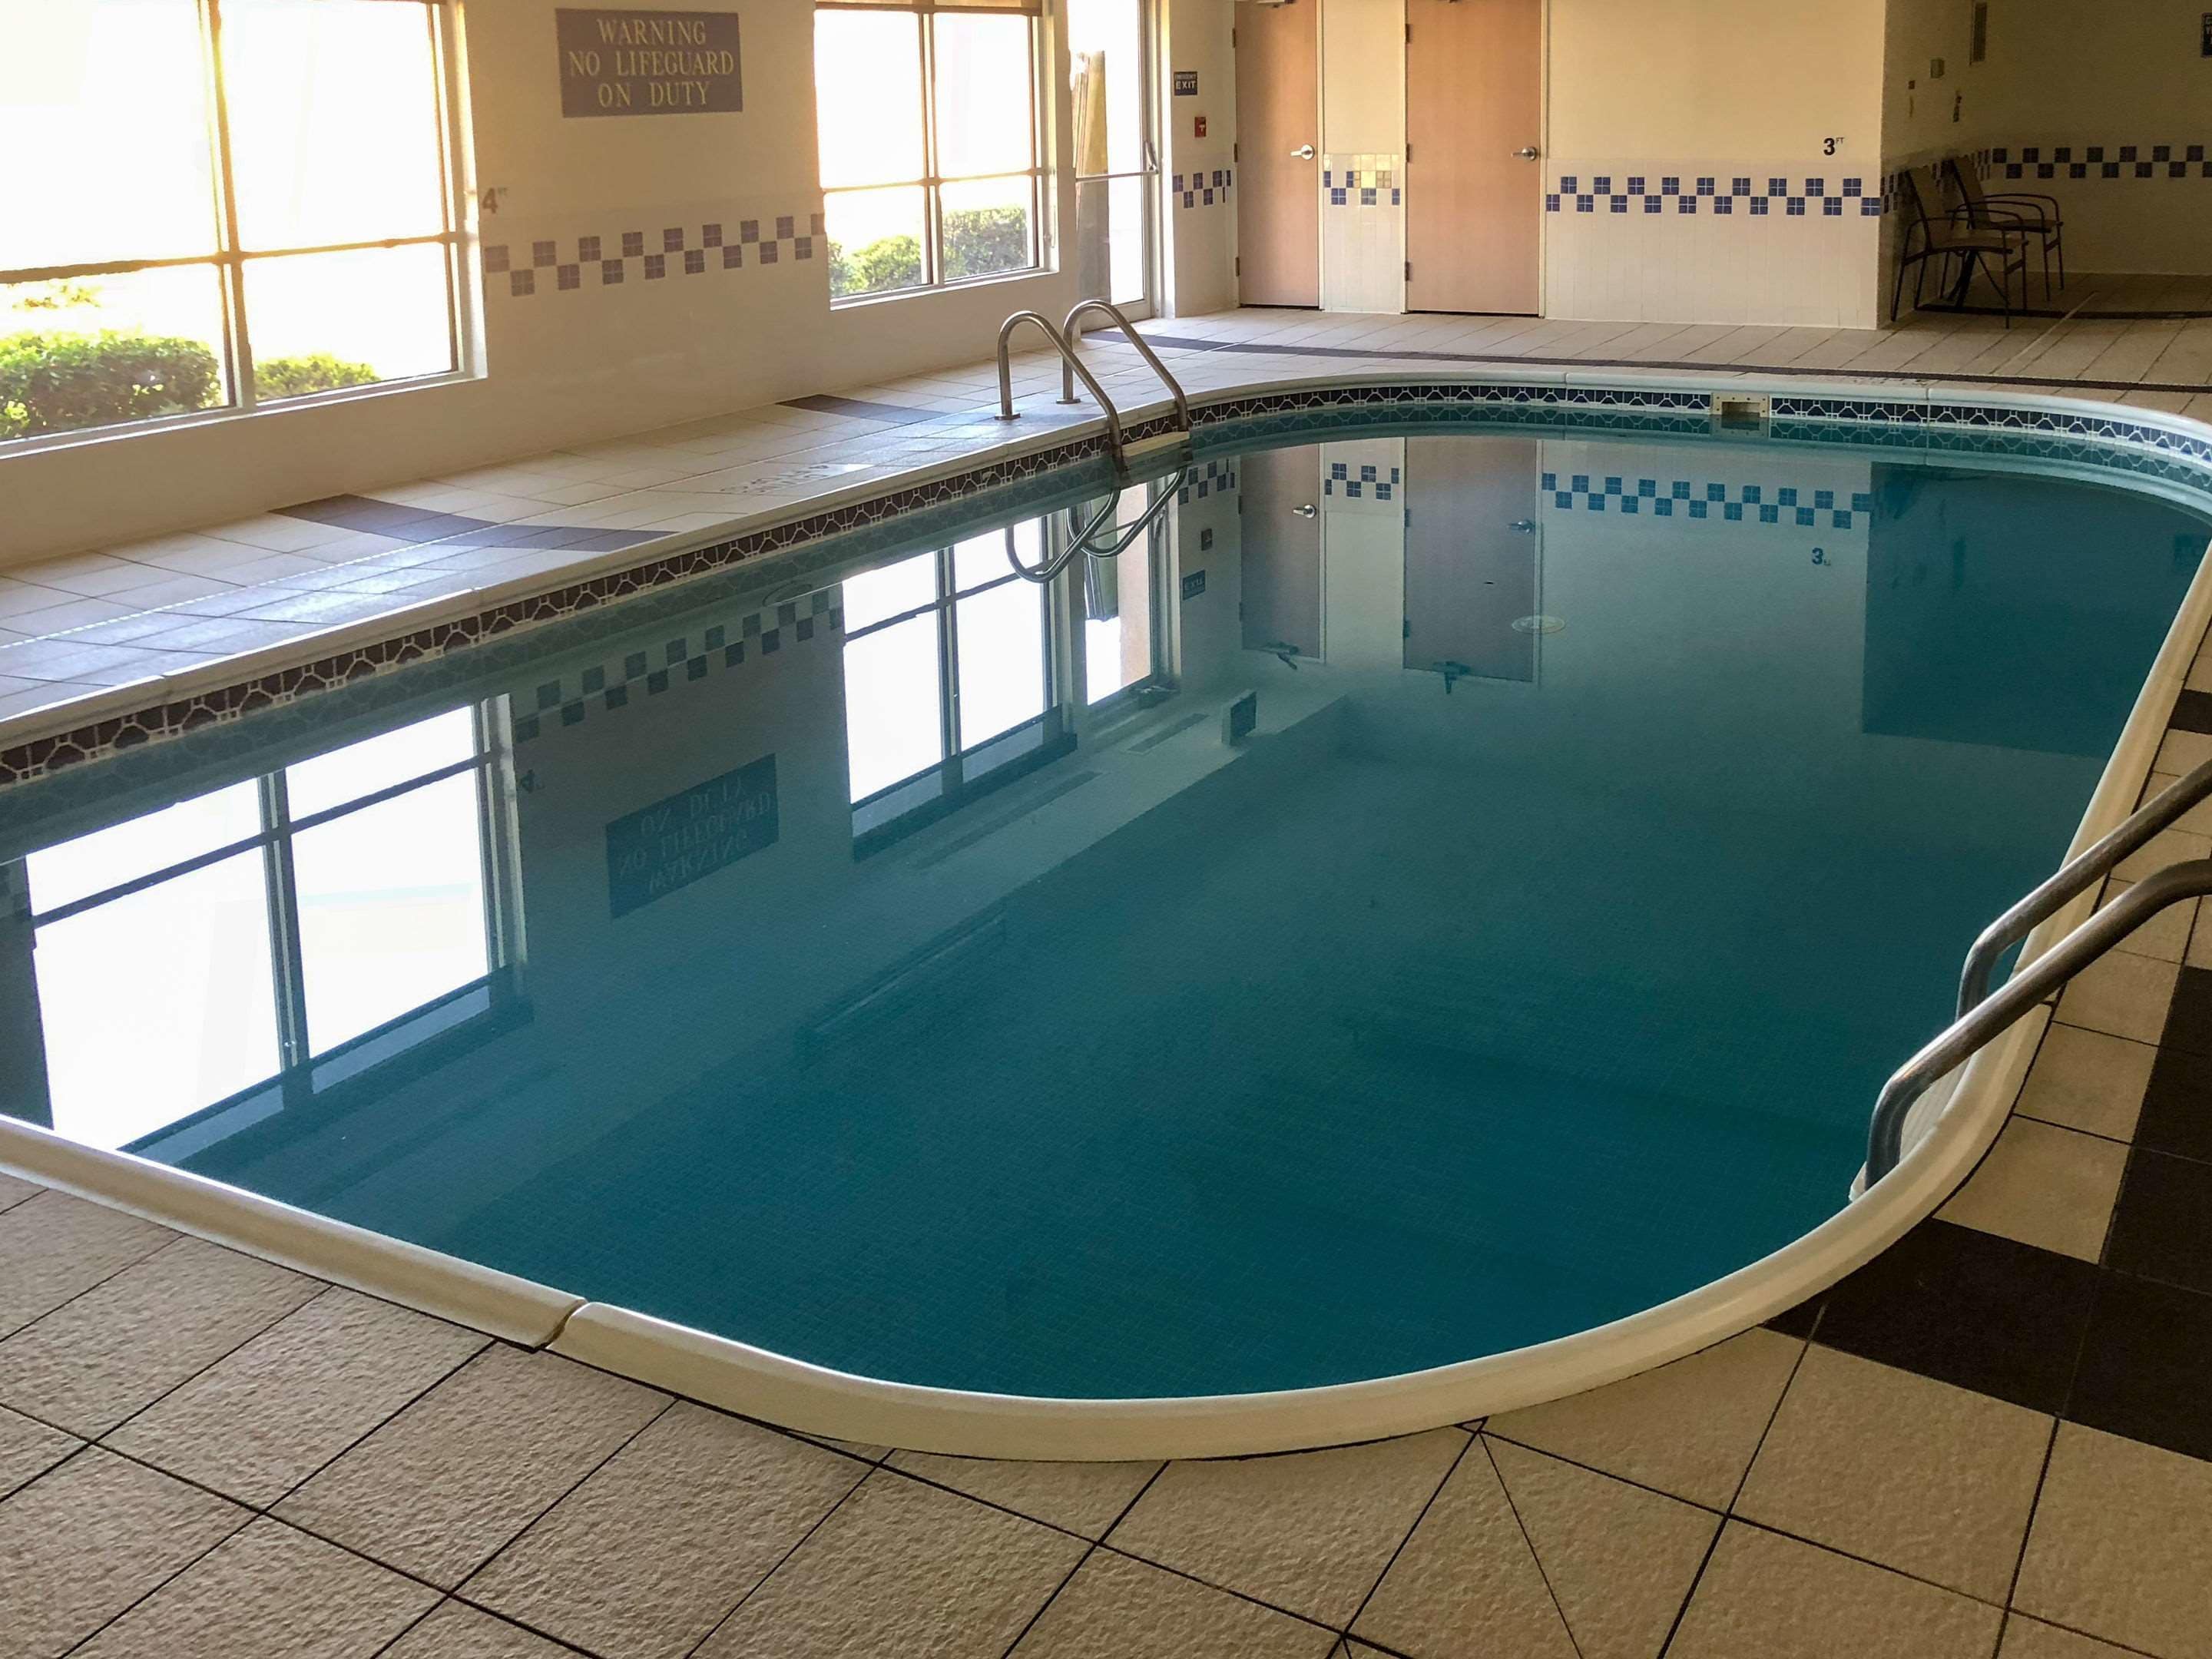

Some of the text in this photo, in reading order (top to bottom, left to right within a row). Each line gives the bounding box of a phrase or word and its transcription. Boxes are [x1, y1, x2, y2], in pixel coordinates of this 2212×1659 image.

[597, 18, 707, 45] WARNING
[568, 51, 734, 76] NO LIFEGUARD
[598, 81, 711, 108] ON DUTY
[1175, 80, 1196, 90] EXIT
